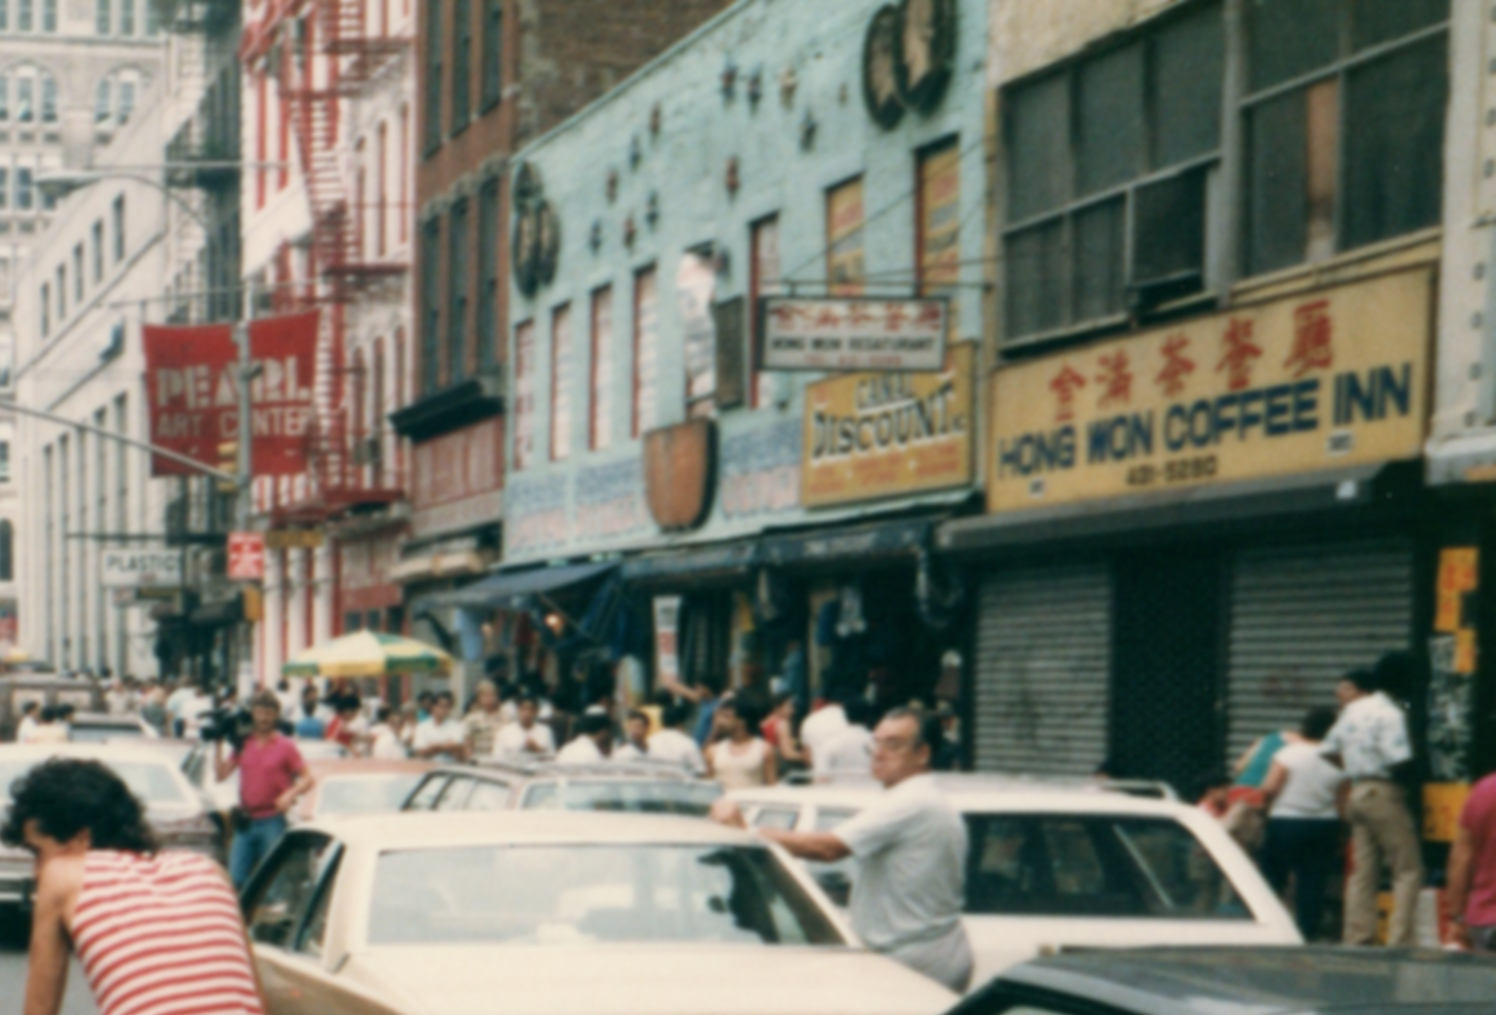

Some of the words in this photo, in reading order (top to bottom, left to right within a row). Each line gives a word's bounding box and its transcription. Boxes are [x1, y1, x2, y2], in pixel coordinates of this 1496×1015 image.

[157, 412, 203, 439] ART
[219, 406, 314, 438] CNTER
[999, 425, 1076, 480] HONG
[1087, 408, 1154, 466] WON
[1164, 379, 1320, 450] COFFEE
[1333, 362, 1413, 426] INN
